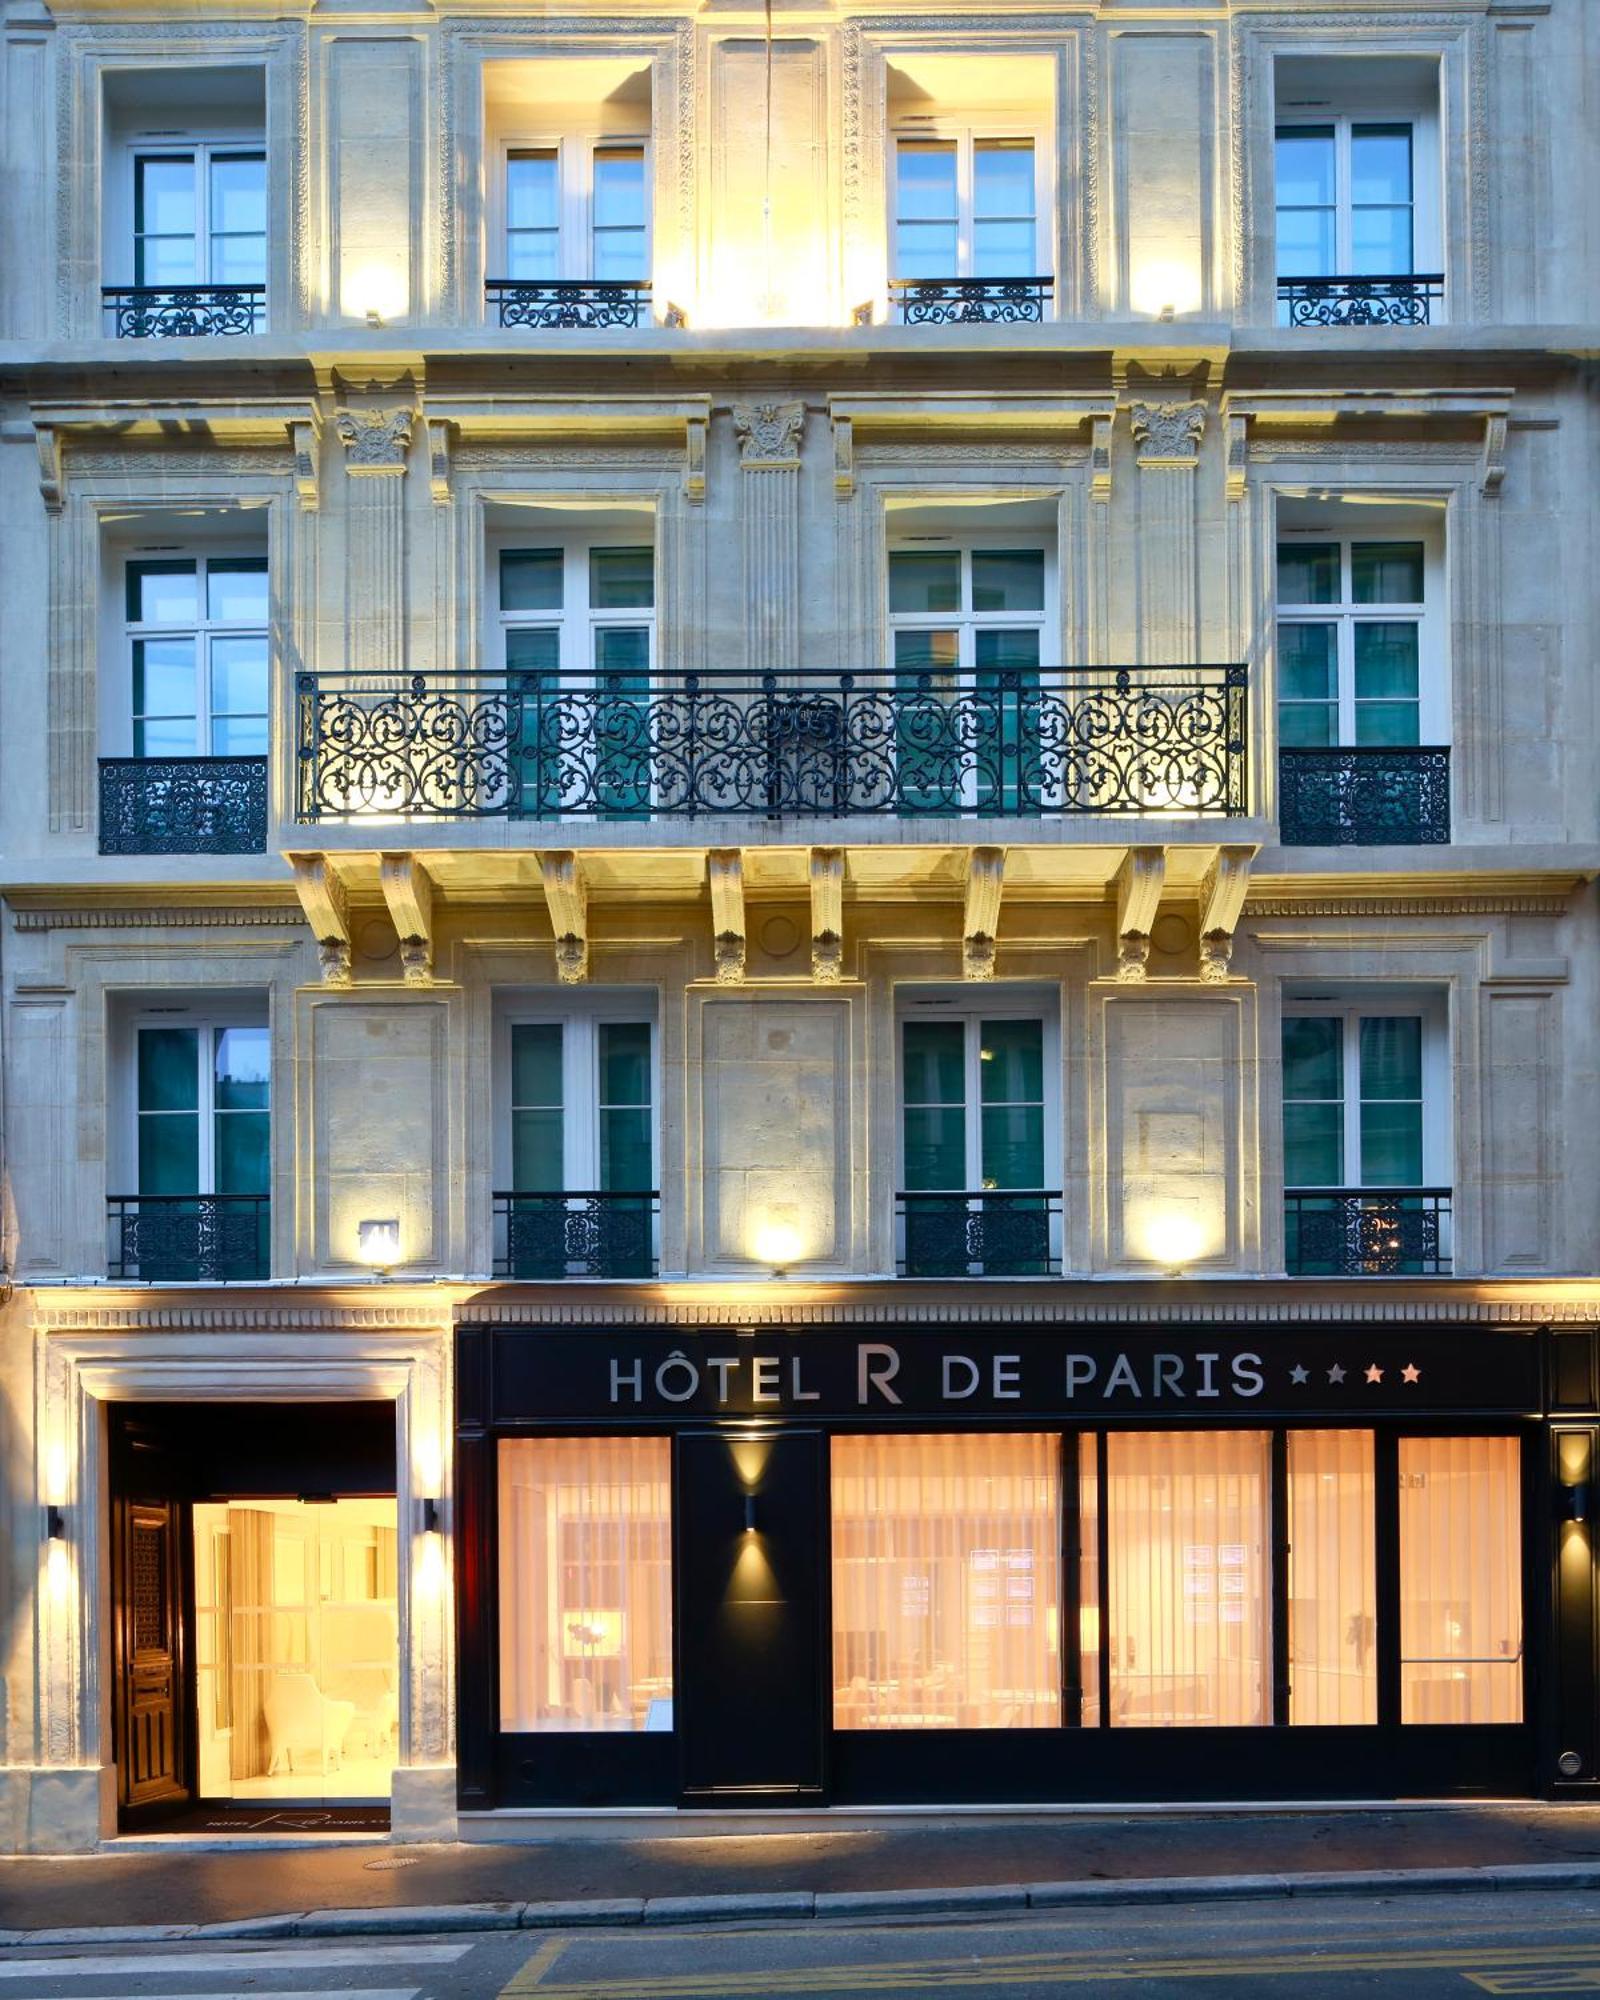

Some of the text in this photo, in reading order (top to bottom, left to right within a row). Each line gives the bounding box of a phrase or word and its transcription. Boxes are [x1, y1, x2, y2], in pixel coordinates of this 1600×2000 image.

[609, 1343, 1264, 1404] HÔTEL R DE PARIS
